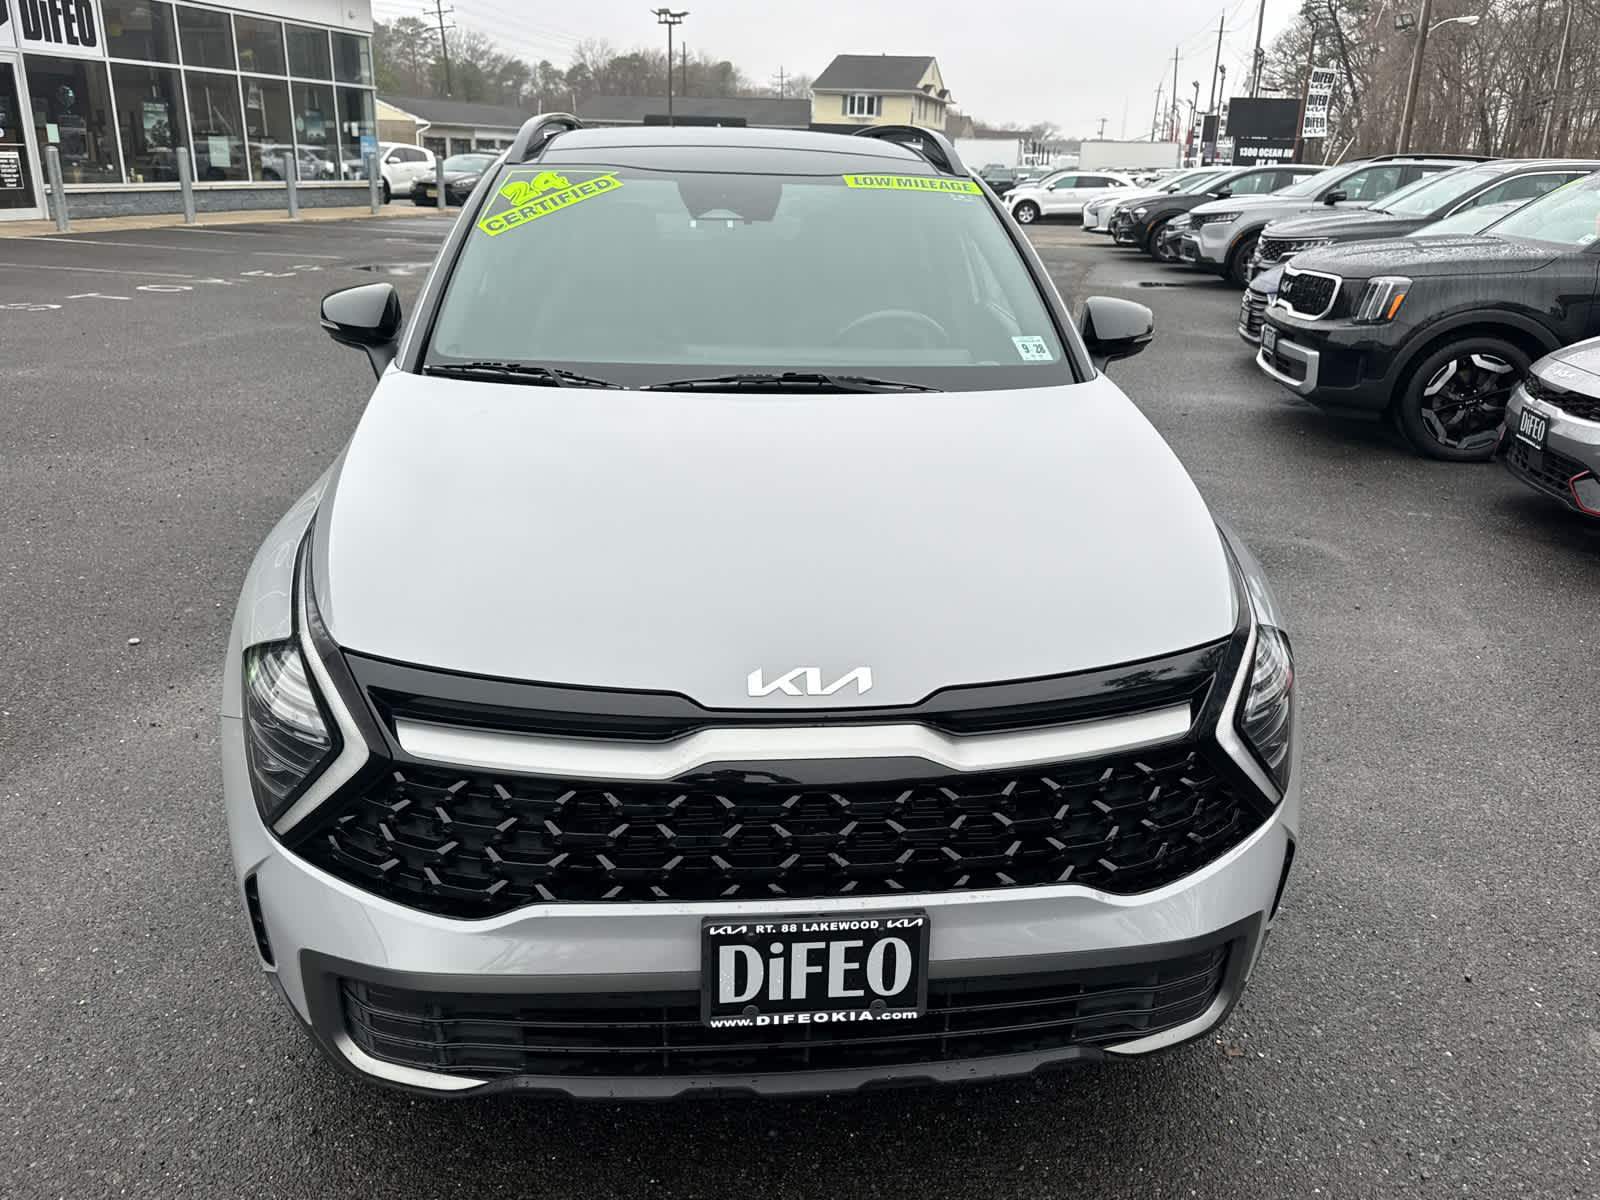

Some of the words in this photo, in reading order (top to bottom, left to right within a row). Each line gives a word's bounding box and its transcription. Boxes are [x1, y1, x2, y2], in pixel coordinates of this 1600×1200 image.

[1259, 147, 1282, 158] OCEAN
[500, 171, 572, 207] 24
[853, 176, 891, 186] LOW
[896, 178, 972, 192] MILEAGE
[485, 179, 611, 232] CERTIFIED
[1520, 411, 1545, 442] DiFEO
[747, 666, 873, 697] KIA
[756, 925, 776, 934] RT.
[781, 924, 797, 933] 88
[802, 921, 879, 932] LAKEWOOD
[718, 936, 913, 1004] DiFEO
[710, 1011, 918, 1028] www.DIFEOKIA.com
